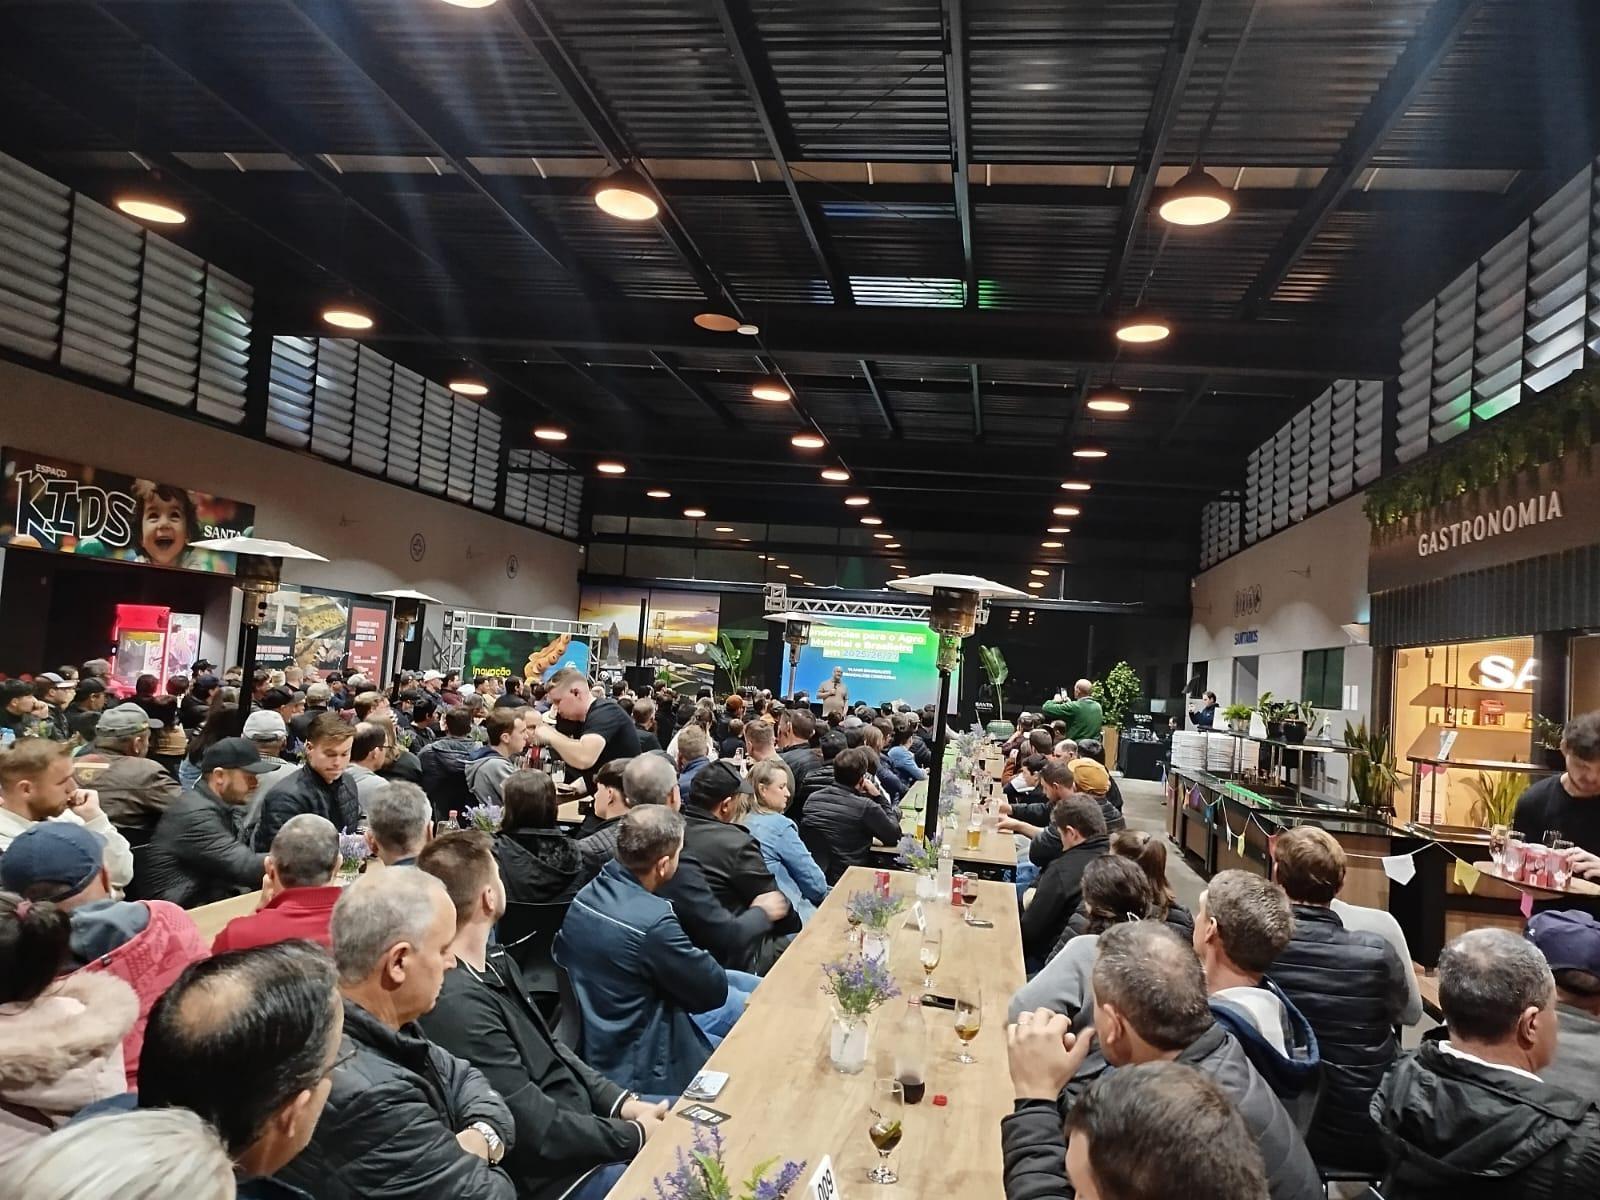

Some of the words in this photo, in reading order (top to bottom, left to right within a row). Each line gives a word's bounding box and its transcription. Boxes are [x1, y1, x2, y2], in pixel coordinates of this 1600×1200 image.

[35, 463, 67, 479] ESPAÇO
[15, 469, 137, 547] KIDS
[203, 524, 242, 538] SANTA
[1418, 490, 1563, 557] GASTRONOMIA
[472, 665, 512, 677] Inovação
[817, 1168, 834, 1200] 009
